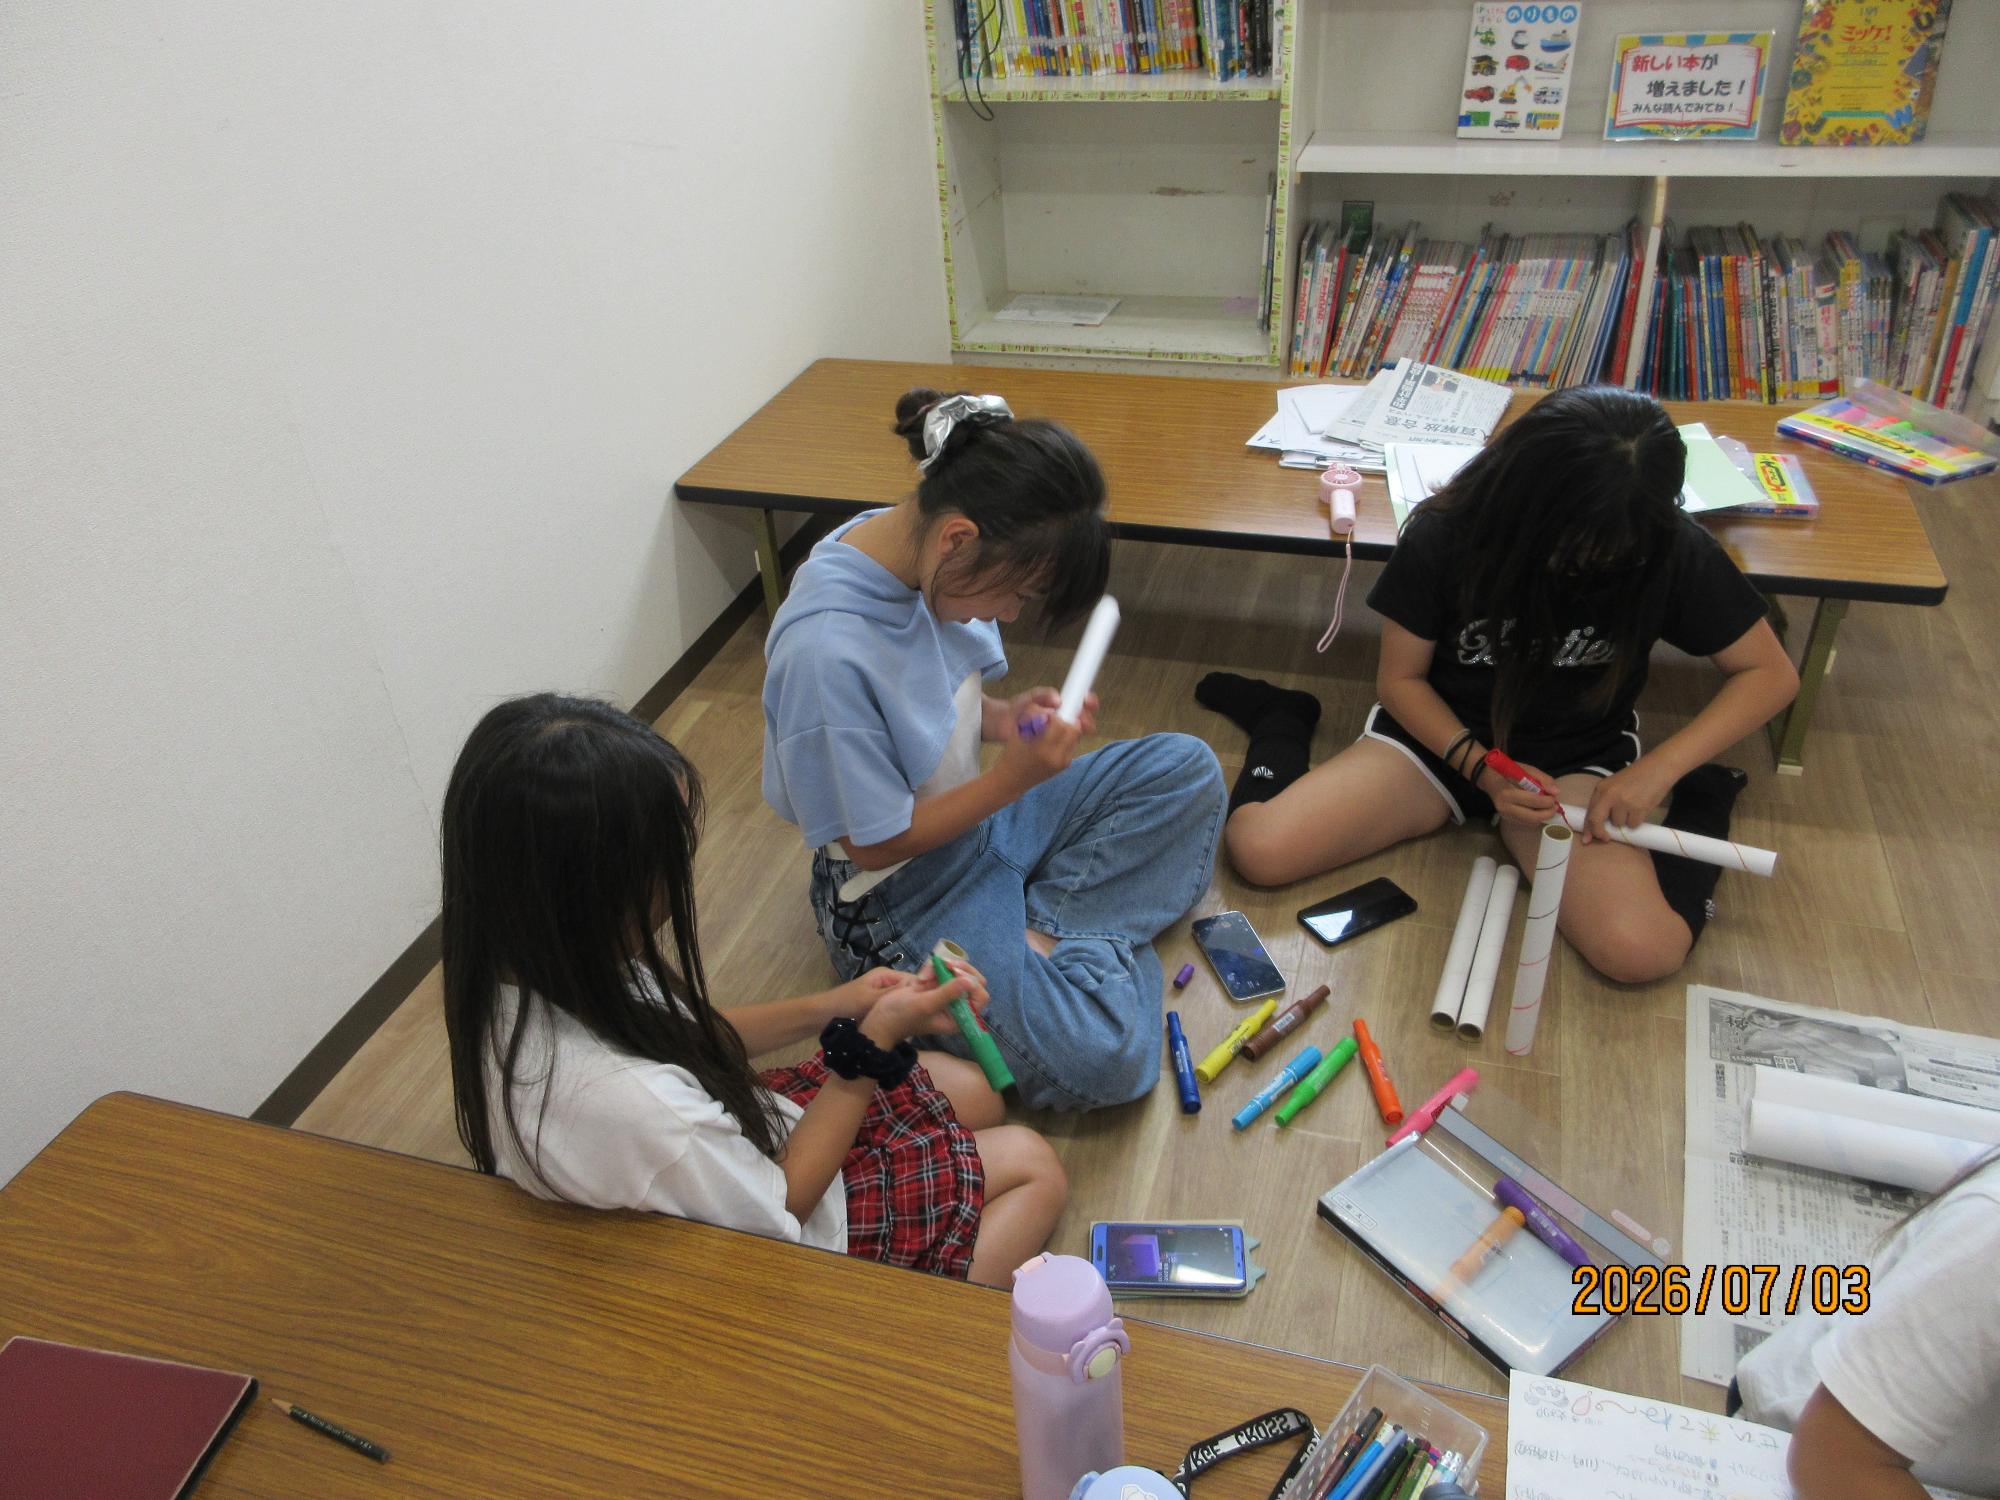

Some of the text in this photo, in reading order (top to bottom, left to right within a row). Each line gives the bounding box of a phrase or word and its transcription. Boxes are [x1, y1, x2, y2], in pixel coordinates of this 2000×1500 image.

[1631, 53, 1719, 72] 新しい本が
[1646, 80, 1746, 98] 増えました!
[1632, 102, 1734, 114] みんな読んでみてね!
